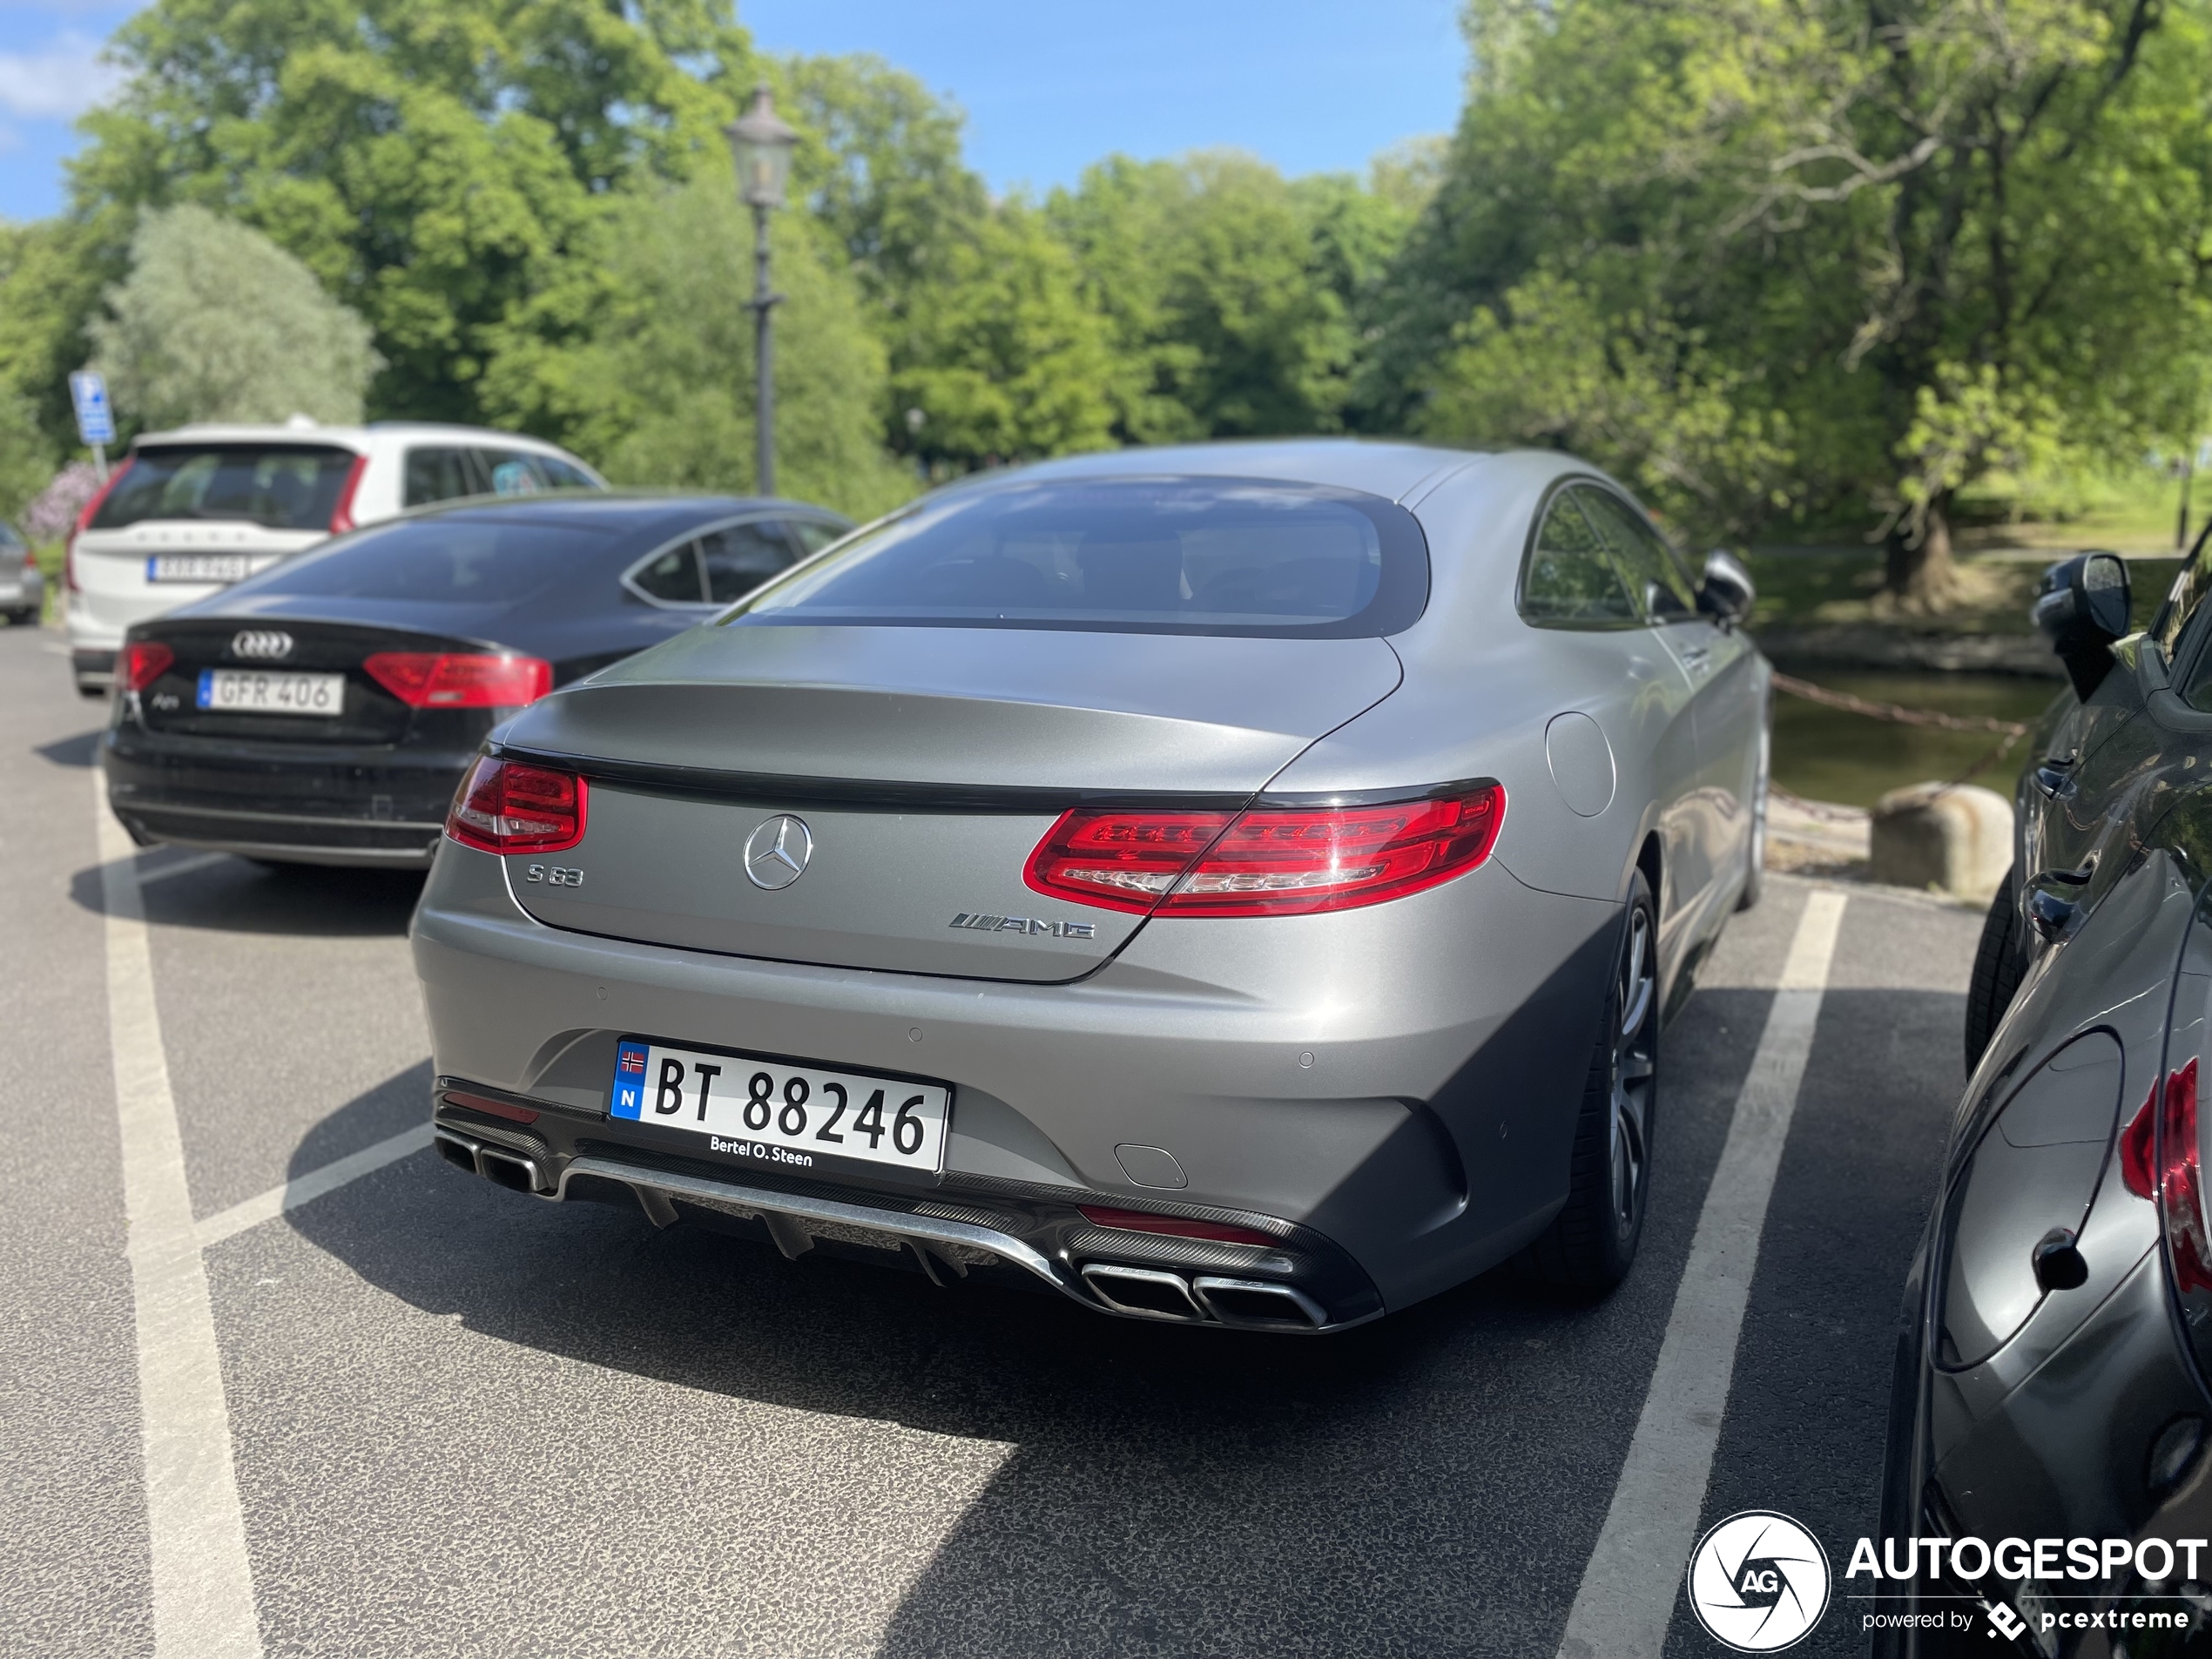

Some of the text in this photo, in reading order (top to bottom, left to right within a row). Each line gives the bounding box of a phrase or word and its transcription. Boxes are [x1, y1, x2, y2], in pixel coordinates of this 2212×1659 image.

[219, 674, 330, 708] GFR 406
[526, 864, 583, 887] S 63
[621, 1089, 634, 1108] N
[655, 1058, 925, 1156] BT 88246
[711, 1136, 813, 1166] Bertel O. Steen
